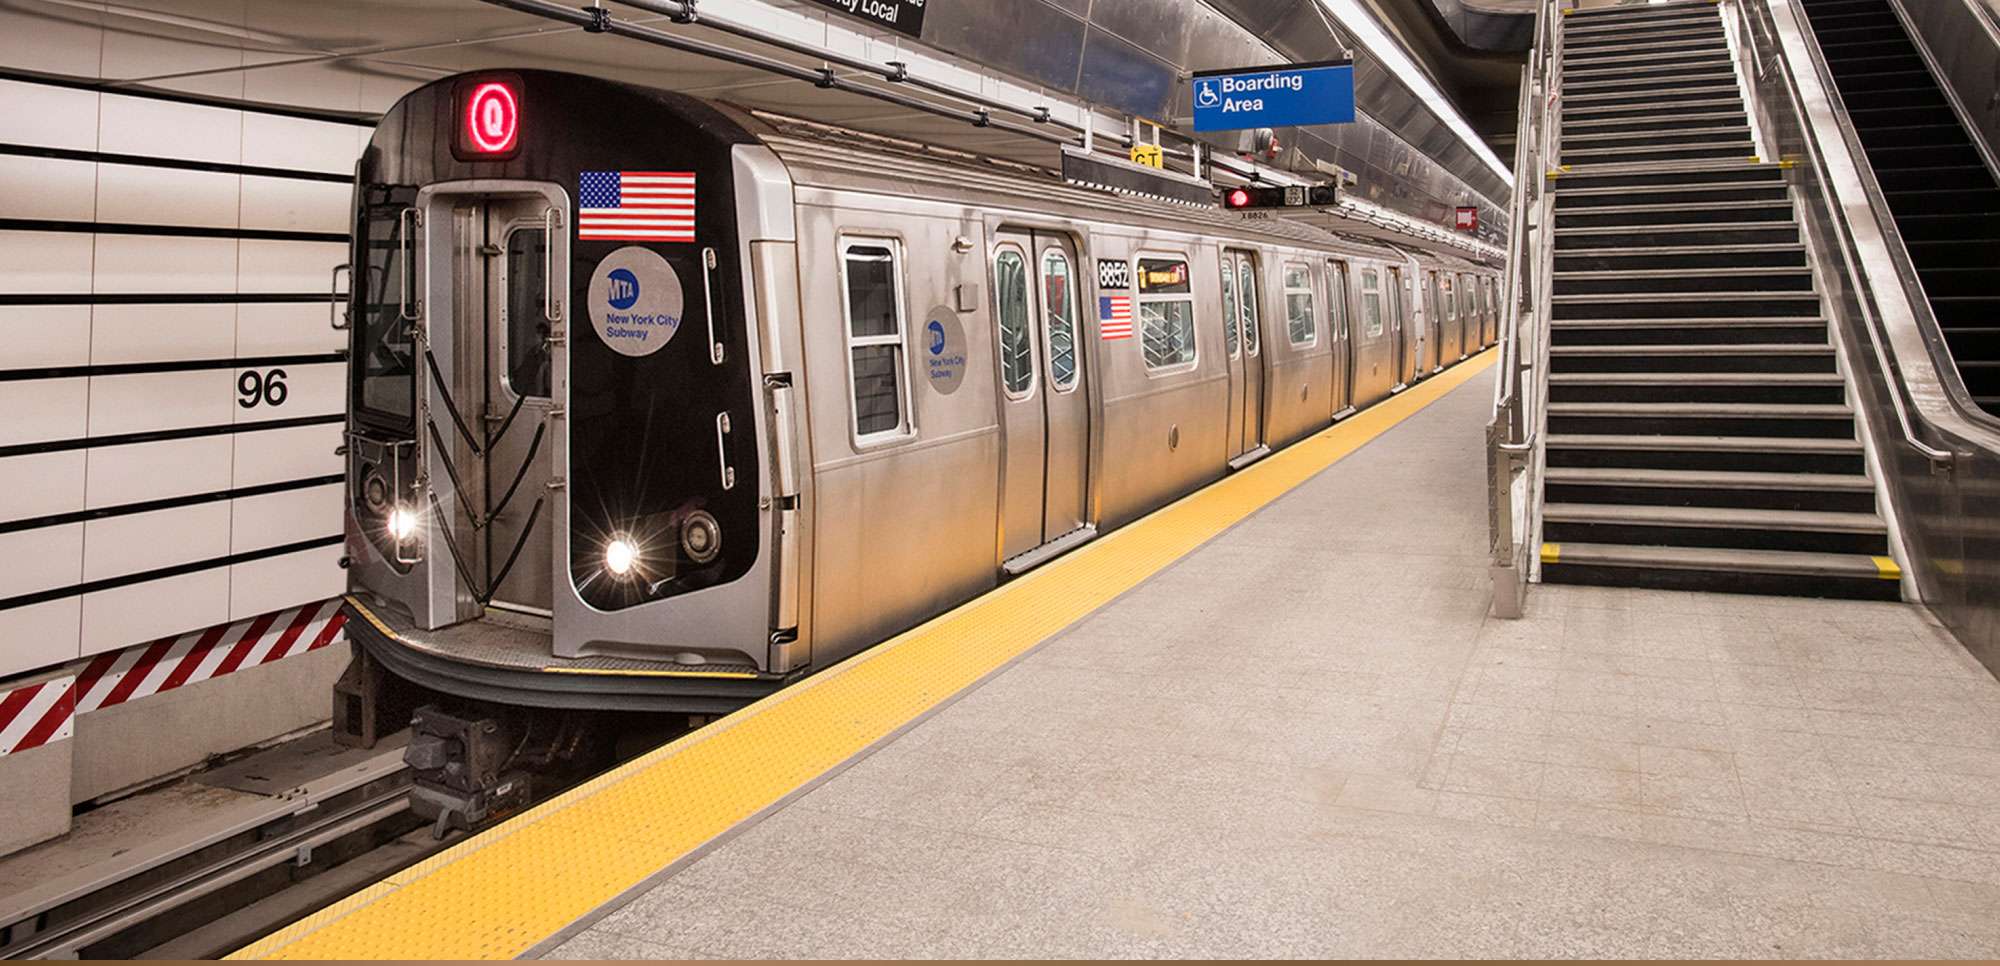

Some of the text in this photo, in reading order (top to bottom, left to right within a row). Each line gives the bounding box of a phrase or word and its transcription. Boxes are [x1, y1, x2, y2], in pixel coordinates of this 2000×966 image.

[861, 0, 899, 23] Local
[1222, 74, 1303, 93] Boarding
[1222, 97, 1263, 113] Area
[483, 98, 504, 136] Q
[1099, 260, 1130, 287] 8852
[607, 277, 635, 301] MTA
[606, 313, 679, 329] New York City
[606, 326, 648, 341] Subway
[238, 369, 288, 408] 96
